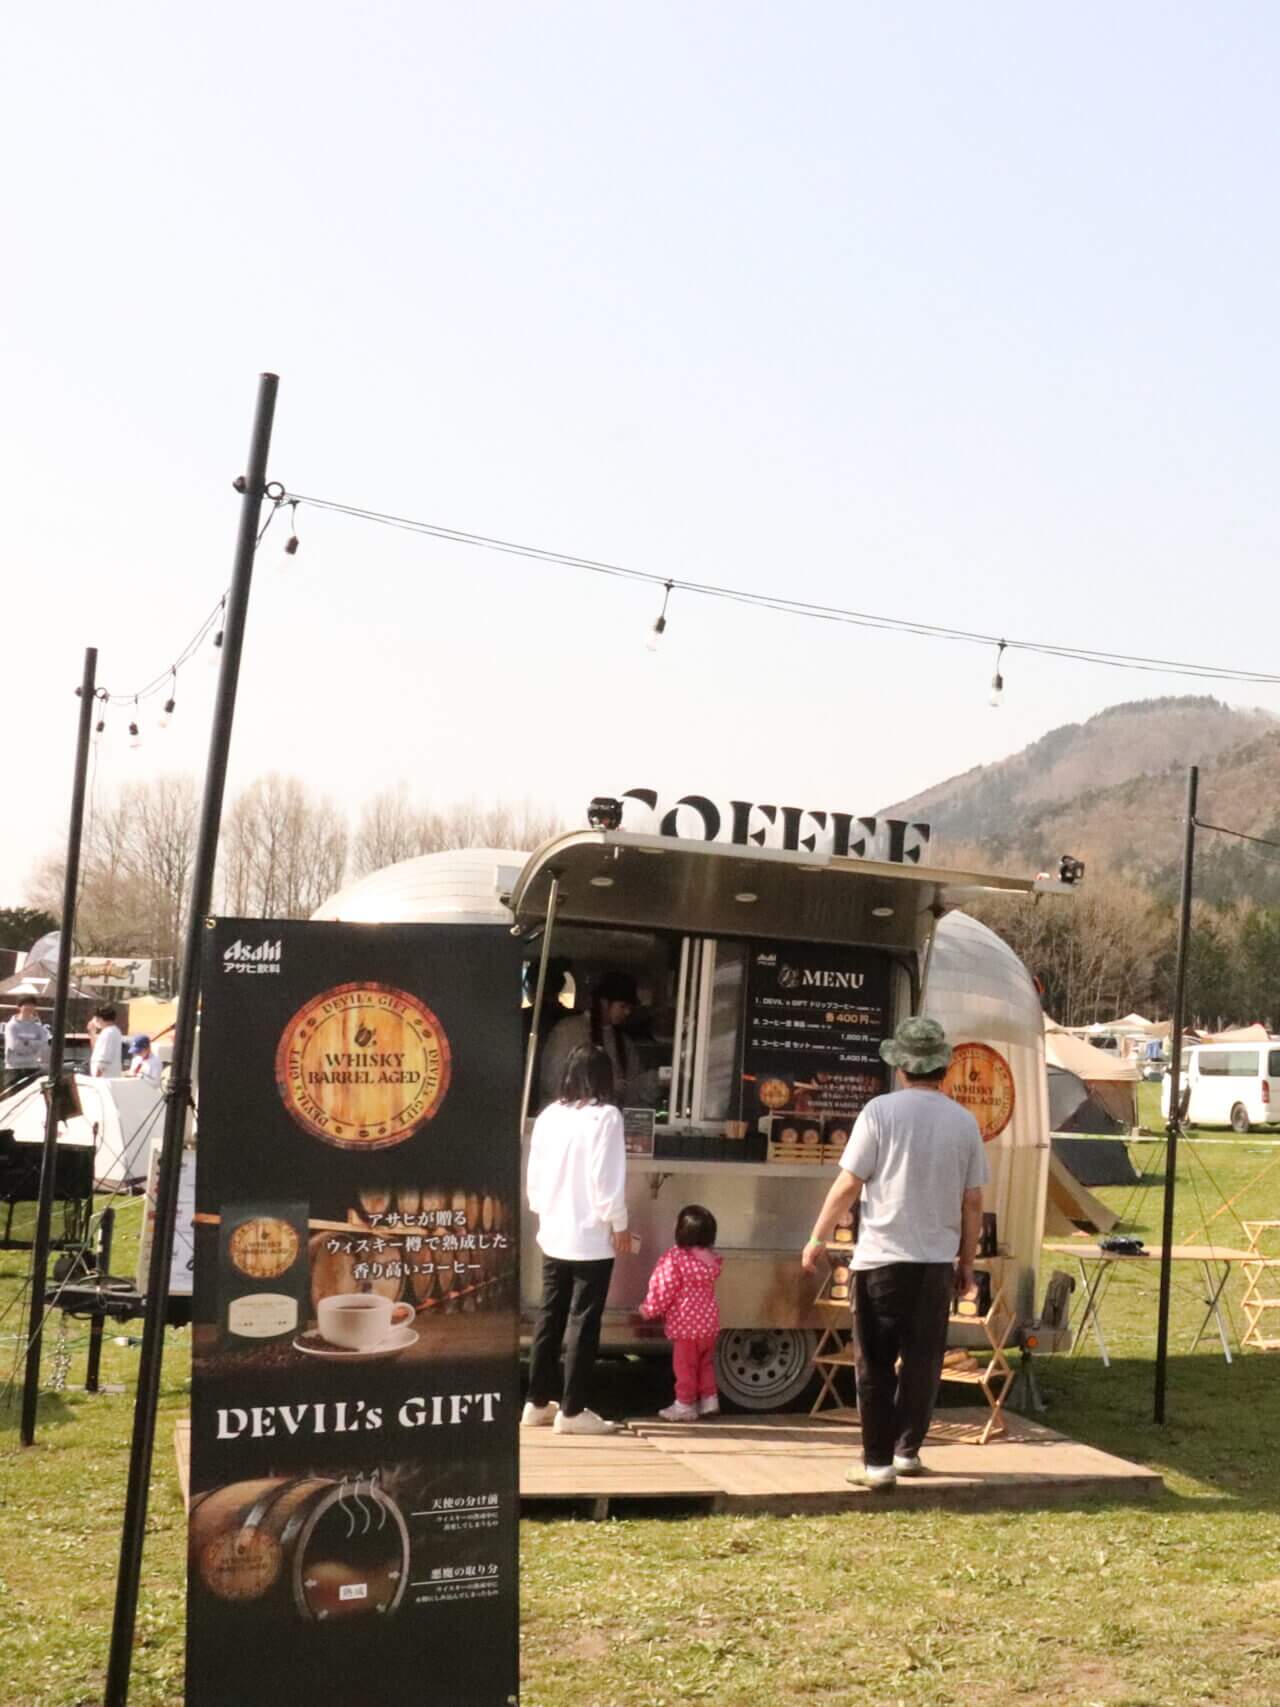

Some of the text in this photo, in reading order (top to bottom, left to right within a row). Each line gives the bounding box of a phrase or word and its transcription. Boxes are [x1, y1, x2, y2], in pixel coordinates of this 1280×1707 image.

[223, 939, 282, 961] Asahi
[802, 969, 865, 989] MENU
[325, 1053, 406, 1067] WHISKY
[308, 1071, 421, 1084] BARREL AGED
[367, 1210, 467, 1228] アサヒが贈る
[327, 1232, 507, 1256] ウィスキー樽で熟成した
[352, 1262, 482, 1280] 香り高いコーヒー
[217, 1393, 501, 1440] DEVIL's GIFT
